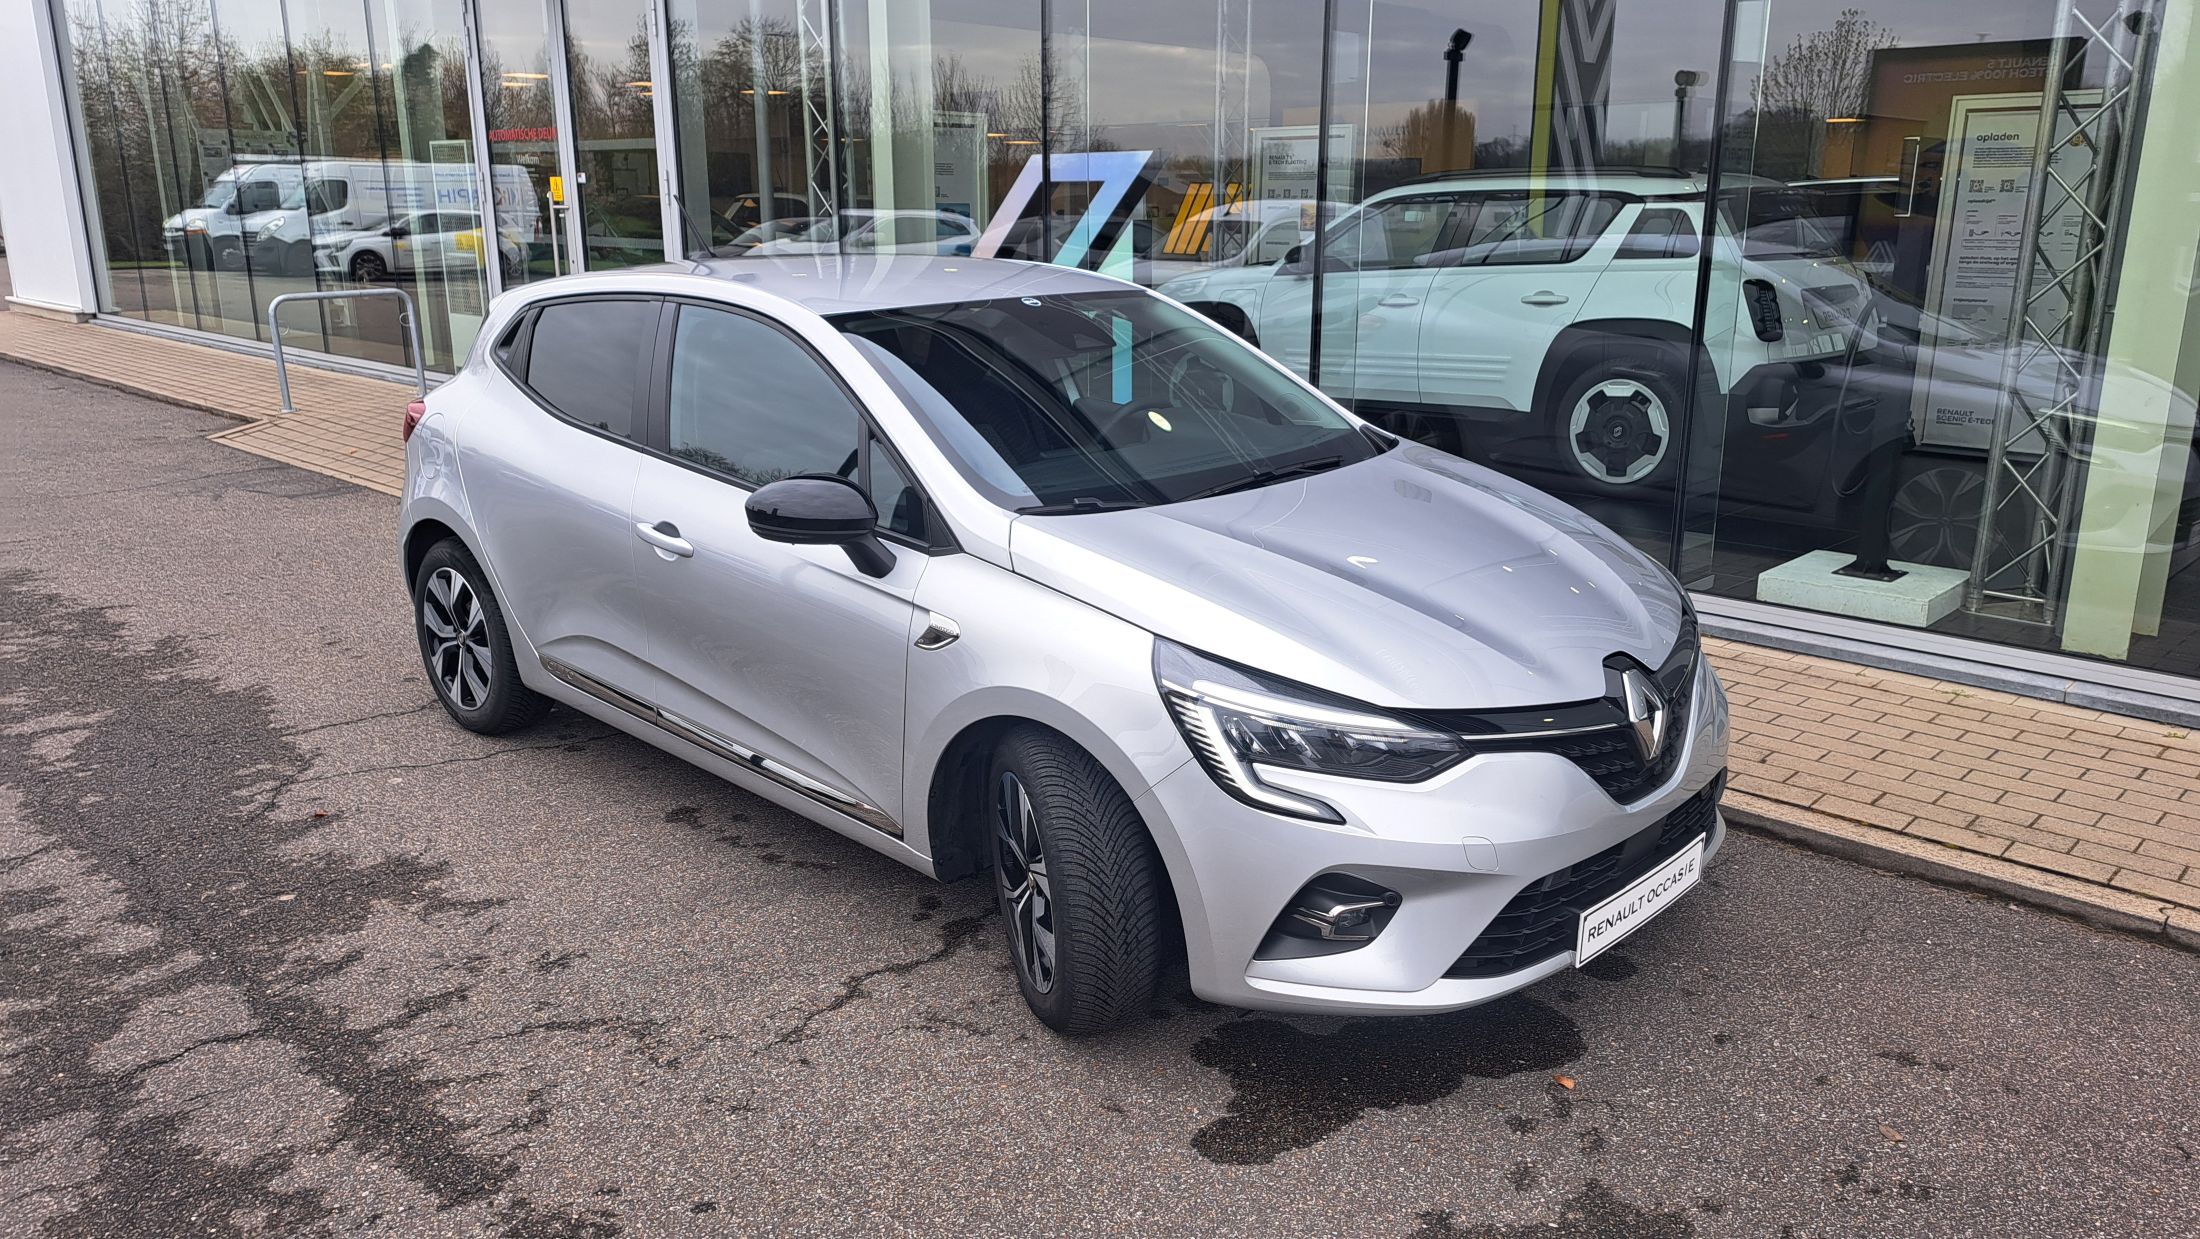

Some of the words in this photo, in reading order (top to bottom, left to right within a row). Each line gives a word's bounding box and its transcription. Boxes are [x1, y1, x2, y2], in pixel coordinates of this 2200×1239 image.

[489, 128, 537, 141] AUTOMATISCHE
[1976, 132, 2020, 143] opladen
[516, 153, 540, 164] Welkom
[1936, 407, 1974, 417] RENAULT
[1936, 415, 1967, 423] SCENIC
[1587, 895, 1645, 942] RENAULT
[1646, 858, 1696, 903] OCCASIE
